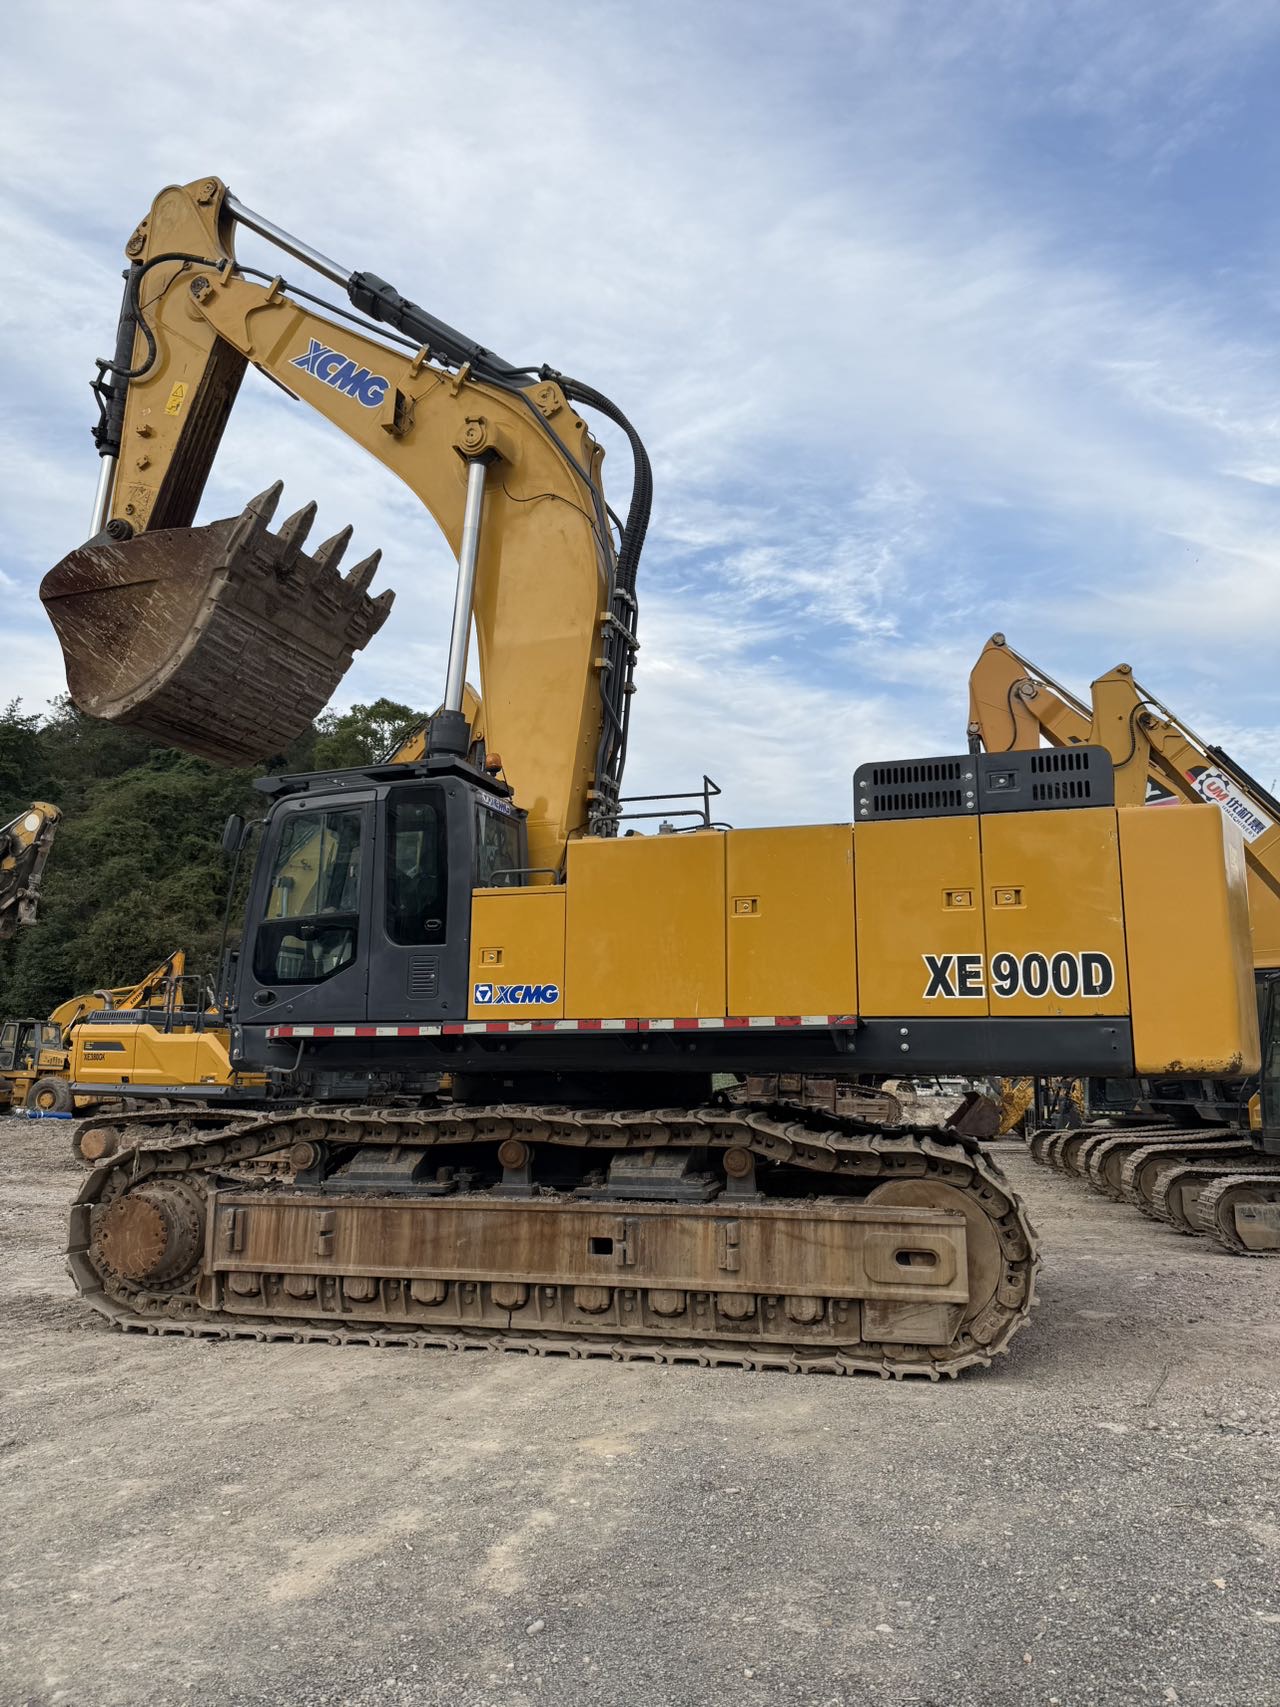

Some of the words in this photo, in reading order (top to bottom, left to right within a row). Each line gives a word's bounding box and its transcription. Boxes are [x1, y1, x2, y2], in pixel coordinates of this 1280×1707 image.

[288, 337, 391, 408] XCMG
[1206, 781, 1230, 802] UM
[1225, 797, 1267, 835] 优机惠
[493, 983, 560, 1005] XCMG
